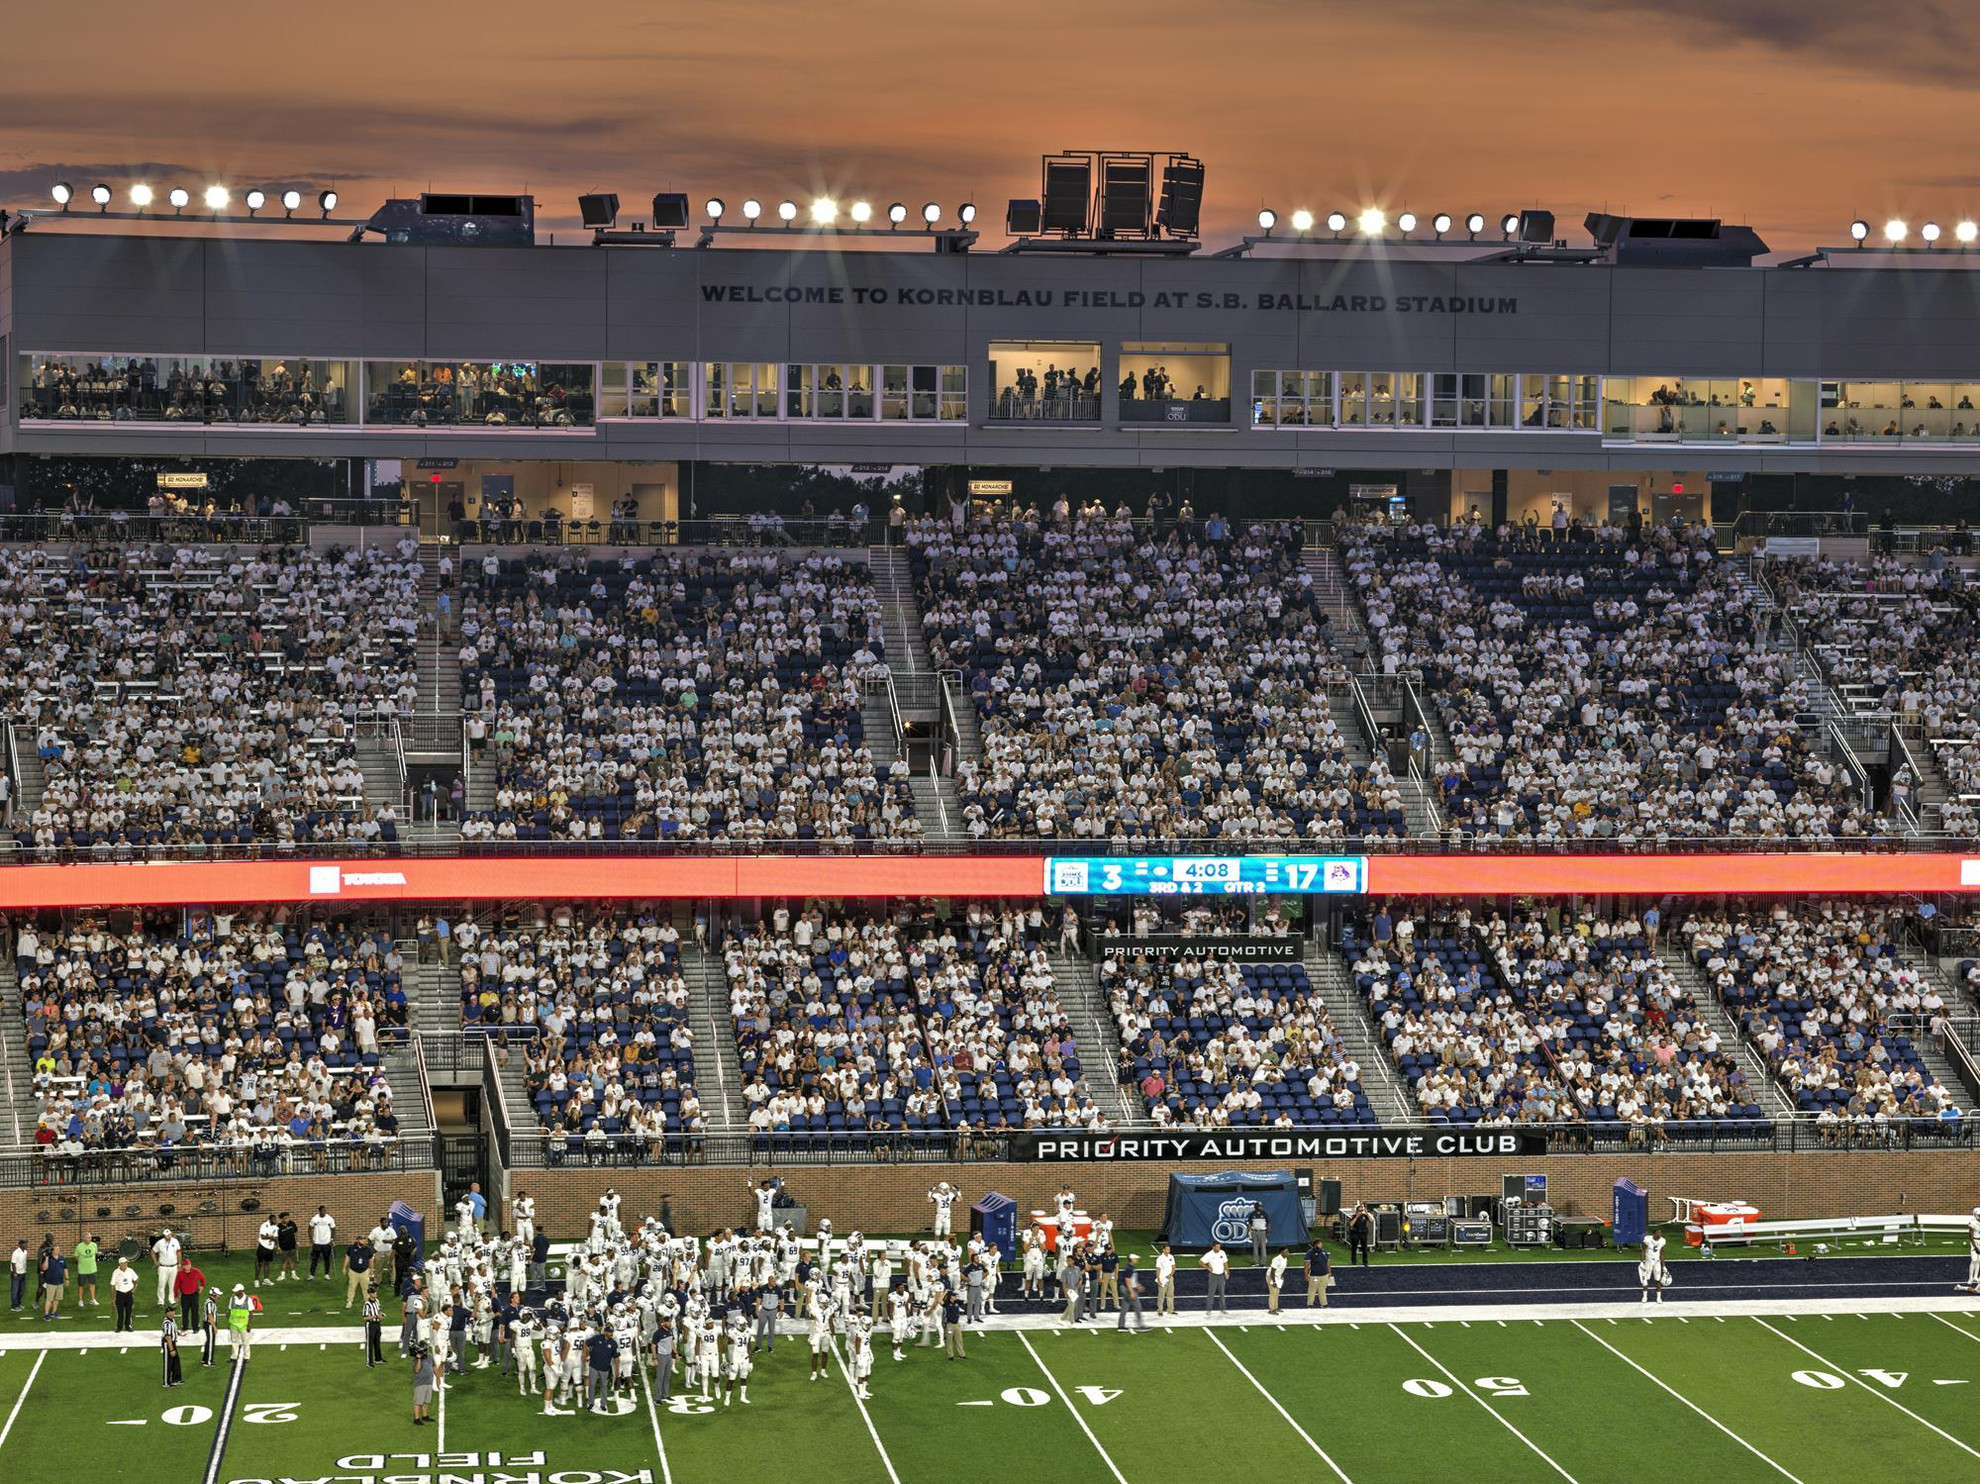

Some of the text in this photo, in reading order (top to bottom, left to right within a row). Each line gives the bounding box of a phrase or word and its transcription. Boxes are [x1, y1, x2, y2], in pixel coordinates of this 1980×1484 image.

[702, 286, 1518, 314] WELCOME TO KORNBLAU FIELD AT S.B. BALLARD STADIUM
[1186, 864, 1228, 877] 4:08
[1102, 865, 1122, 890] 3
[1285, 864, 1318, 889] 17
[1149, 882, 1178, 893] 3RD
[1193, 882, 1203, 893] 2
[1224, 882, 1266, 893] QTR 2
[1105, 946, 1294, 956] PRIORITY AUTOMOTIVE
[332, 1014, 339, 1024] 7
[1038, 1135, 1517, 1158] PRIORITY AUTOMOTIVE CLUB
[763, 1195, 769, 1204] 2
[940, 1199, 950, 1209] 35
[1062, 1244, 1072, 1252] 41
[739, 1257, 750, 1266] 97
[520, 1327, 531, 1338] 89
[619, 1337, 631, 1350] 52
[737, 1337, 748, 1348] 34
[336, 1451, 547, 1469] FIELD
